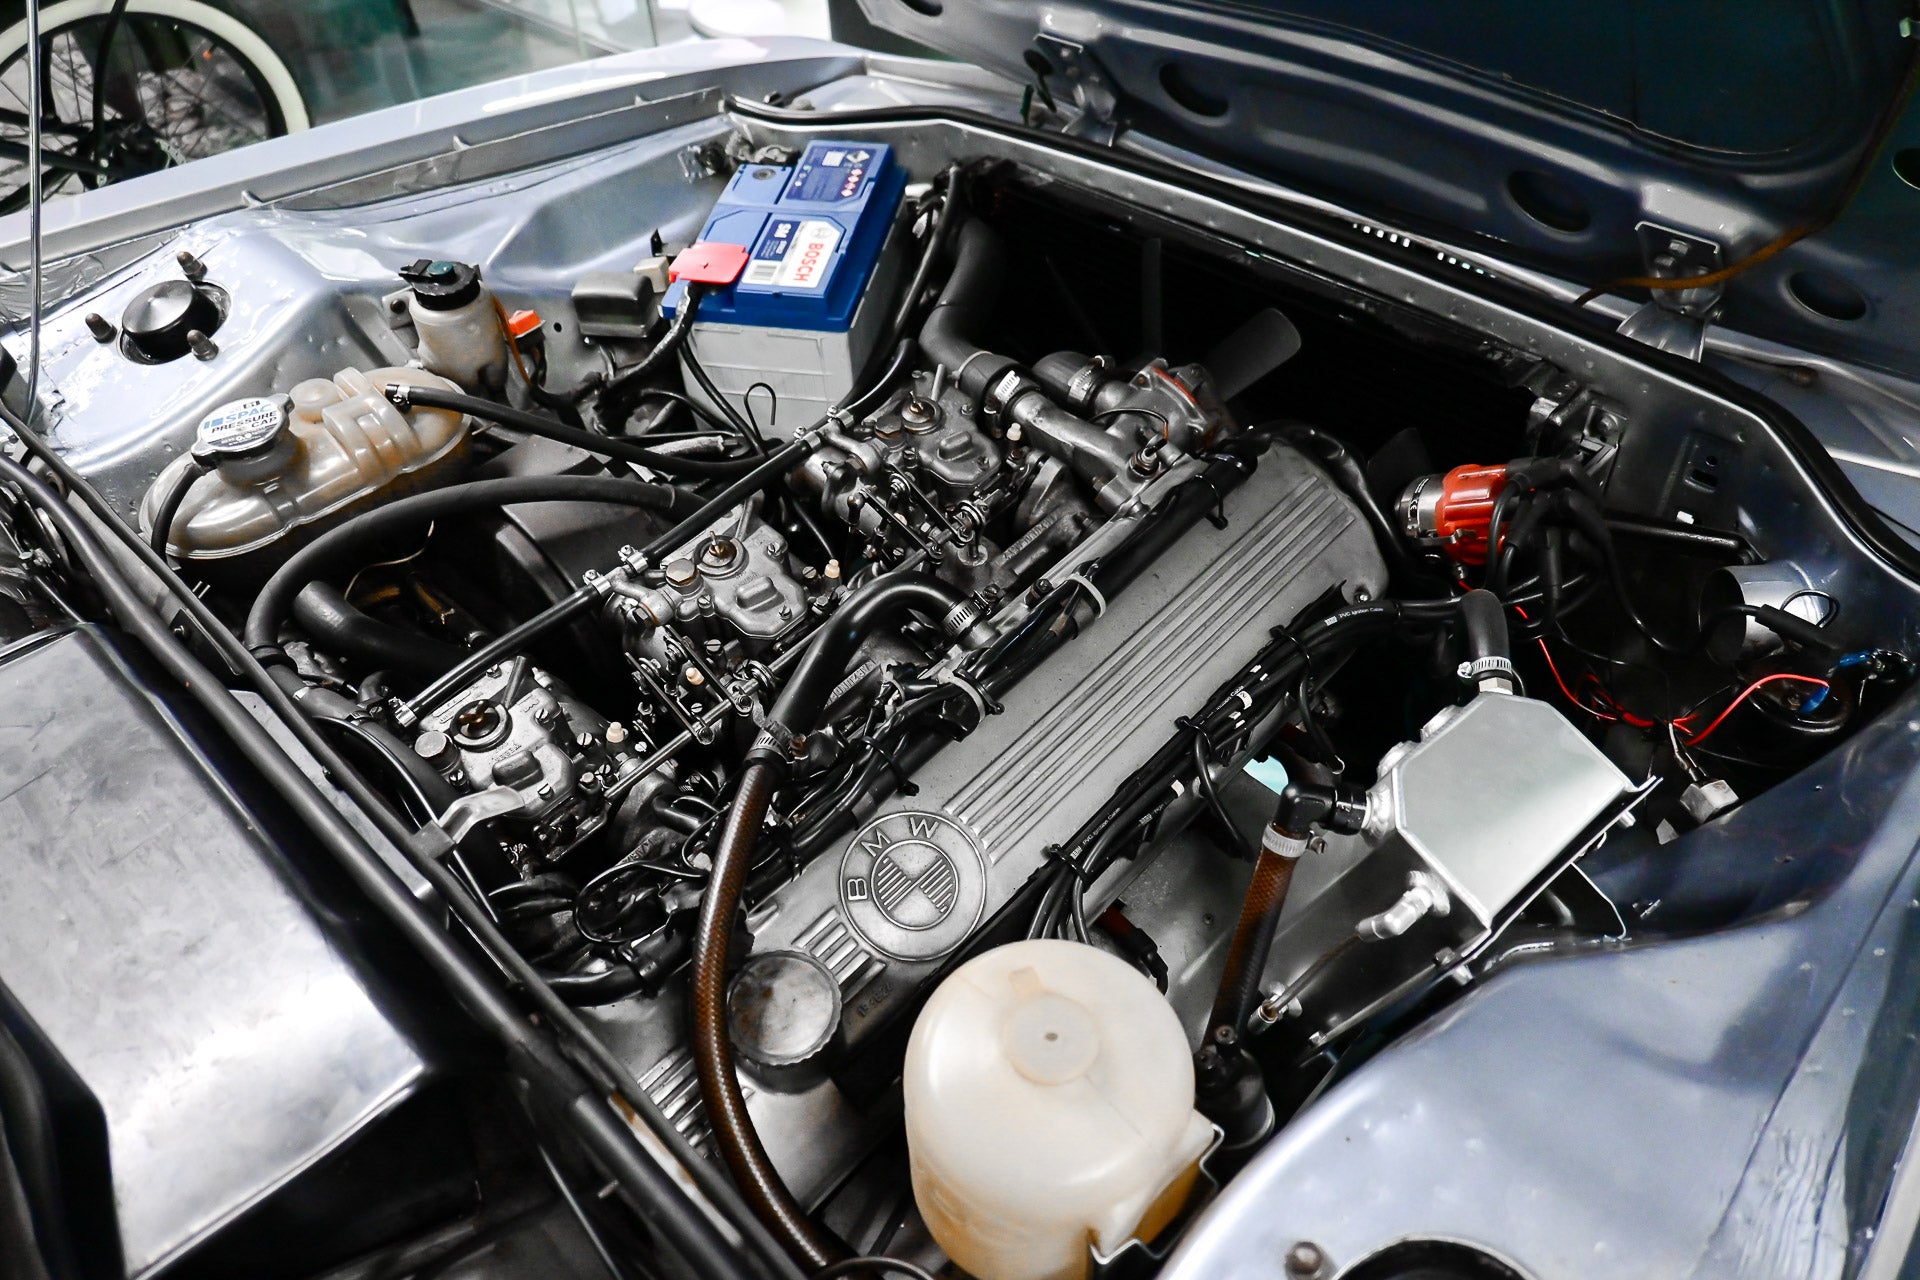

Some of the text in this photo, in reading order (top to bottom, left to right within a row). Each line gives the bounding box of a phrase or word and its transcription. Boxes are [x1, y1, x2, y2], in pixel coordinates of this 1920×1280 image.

[793, 243, 824, 282] BOSCH
[211, 410, 277, 433] PRESSURE
[251, 416, 277, 428] CAP
[847, 817, 939, 900] BMW
